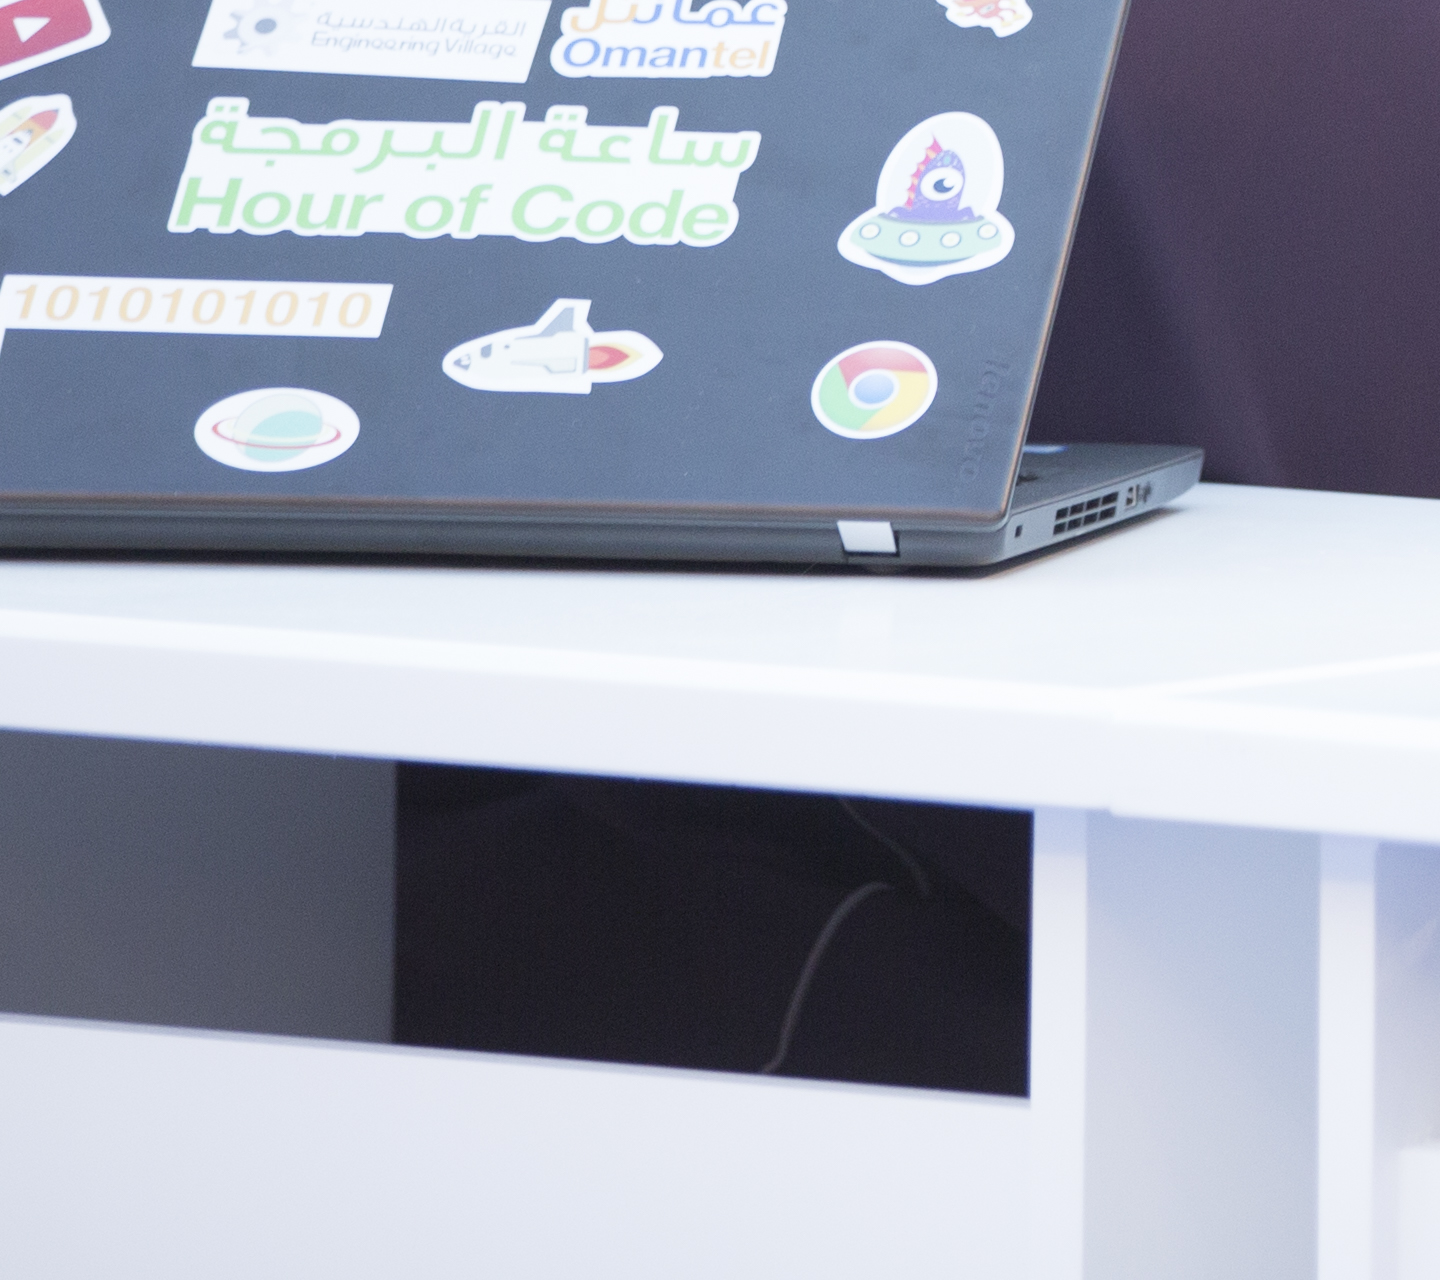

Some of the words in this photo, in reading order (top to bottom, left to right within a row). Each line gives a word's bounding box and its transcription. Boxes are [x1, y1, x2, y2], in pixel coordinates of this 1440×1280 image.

[310, 30, 440, 56] Engineering
[444, 37, 519, 60] Village
[563, 37, 771, 69] Omantel
[200, 105, 517, 174] البرمجة
[538, 113, 751, 168] ساعة
[175, 176, 385, 231] Hour
[404, 183, 494, 233] of
[511, 184, 730, 241] Code
[15, 283, 374, 329] 1010101010
